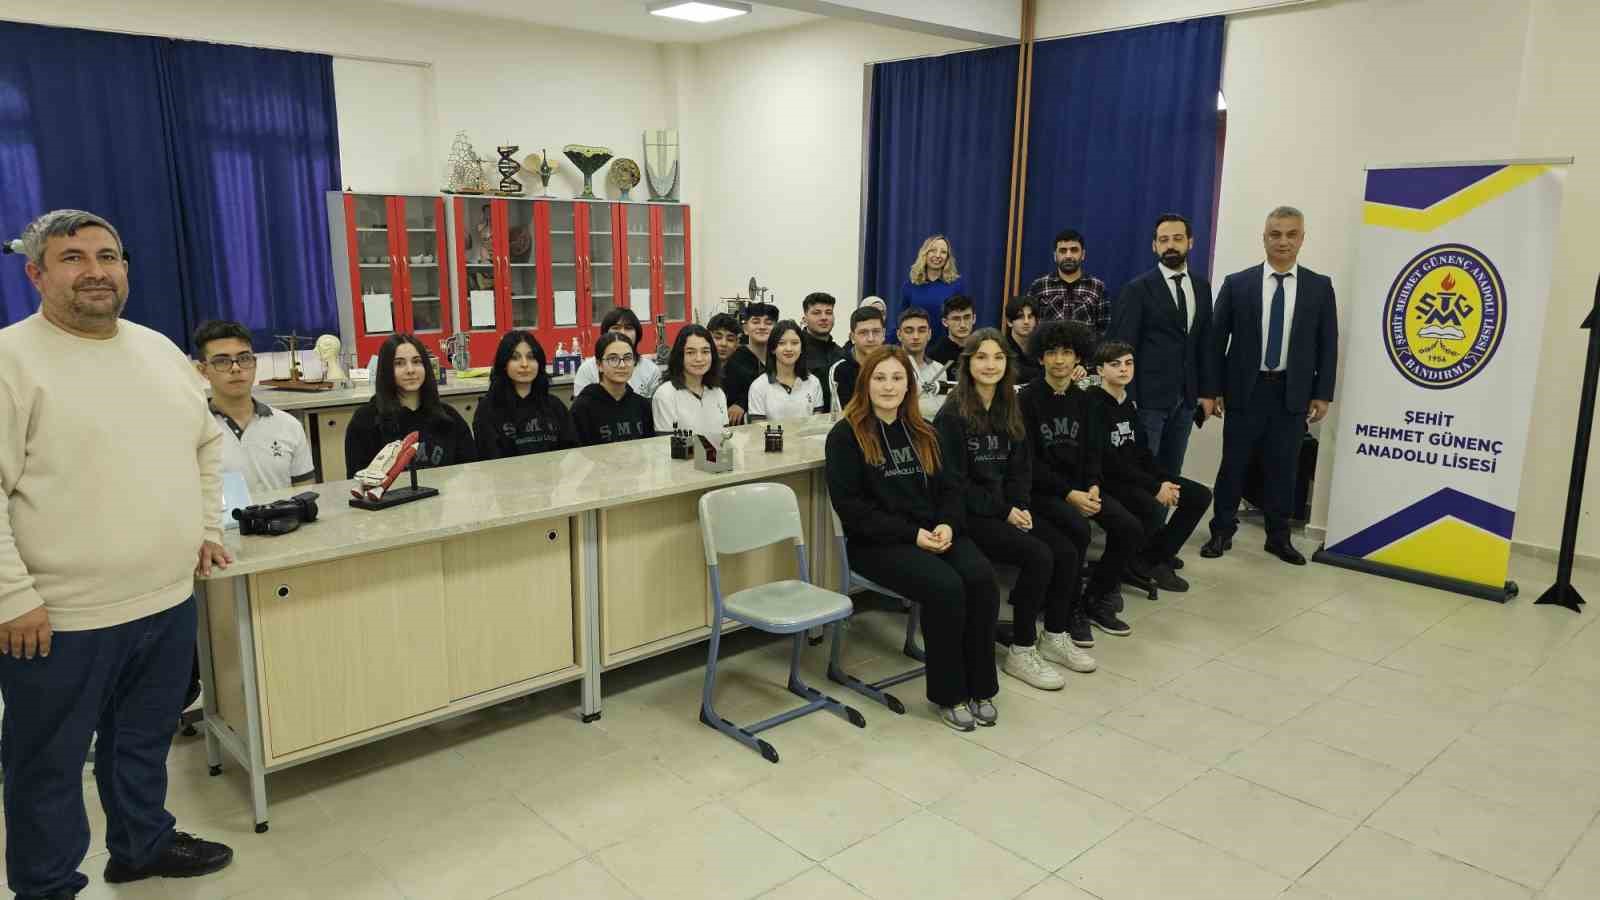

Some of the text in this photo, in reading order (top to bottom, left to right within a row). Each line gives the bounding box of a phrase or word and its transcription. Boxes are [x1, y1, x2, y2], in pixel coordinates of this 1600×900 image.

[1422, 255, 1473, 272] GÜNENÇ
[1396, 269, 1425, 314] MEHMET
[1471, 268, 1496, 316] ANADOLU
[1392, 314, 1407, 345] ŞEHİT
[1474, 318, 1496, 352] LİSESİ
[1405, 358, 1473, 380] BANDIRMA
[1404, 410, 1454, 427] ŞEHİT
[1355, 423, 1504, 456] MEHMET GÜNENÇ
[1356, 443, 1497, 474] ANADOLU LİSESİ
